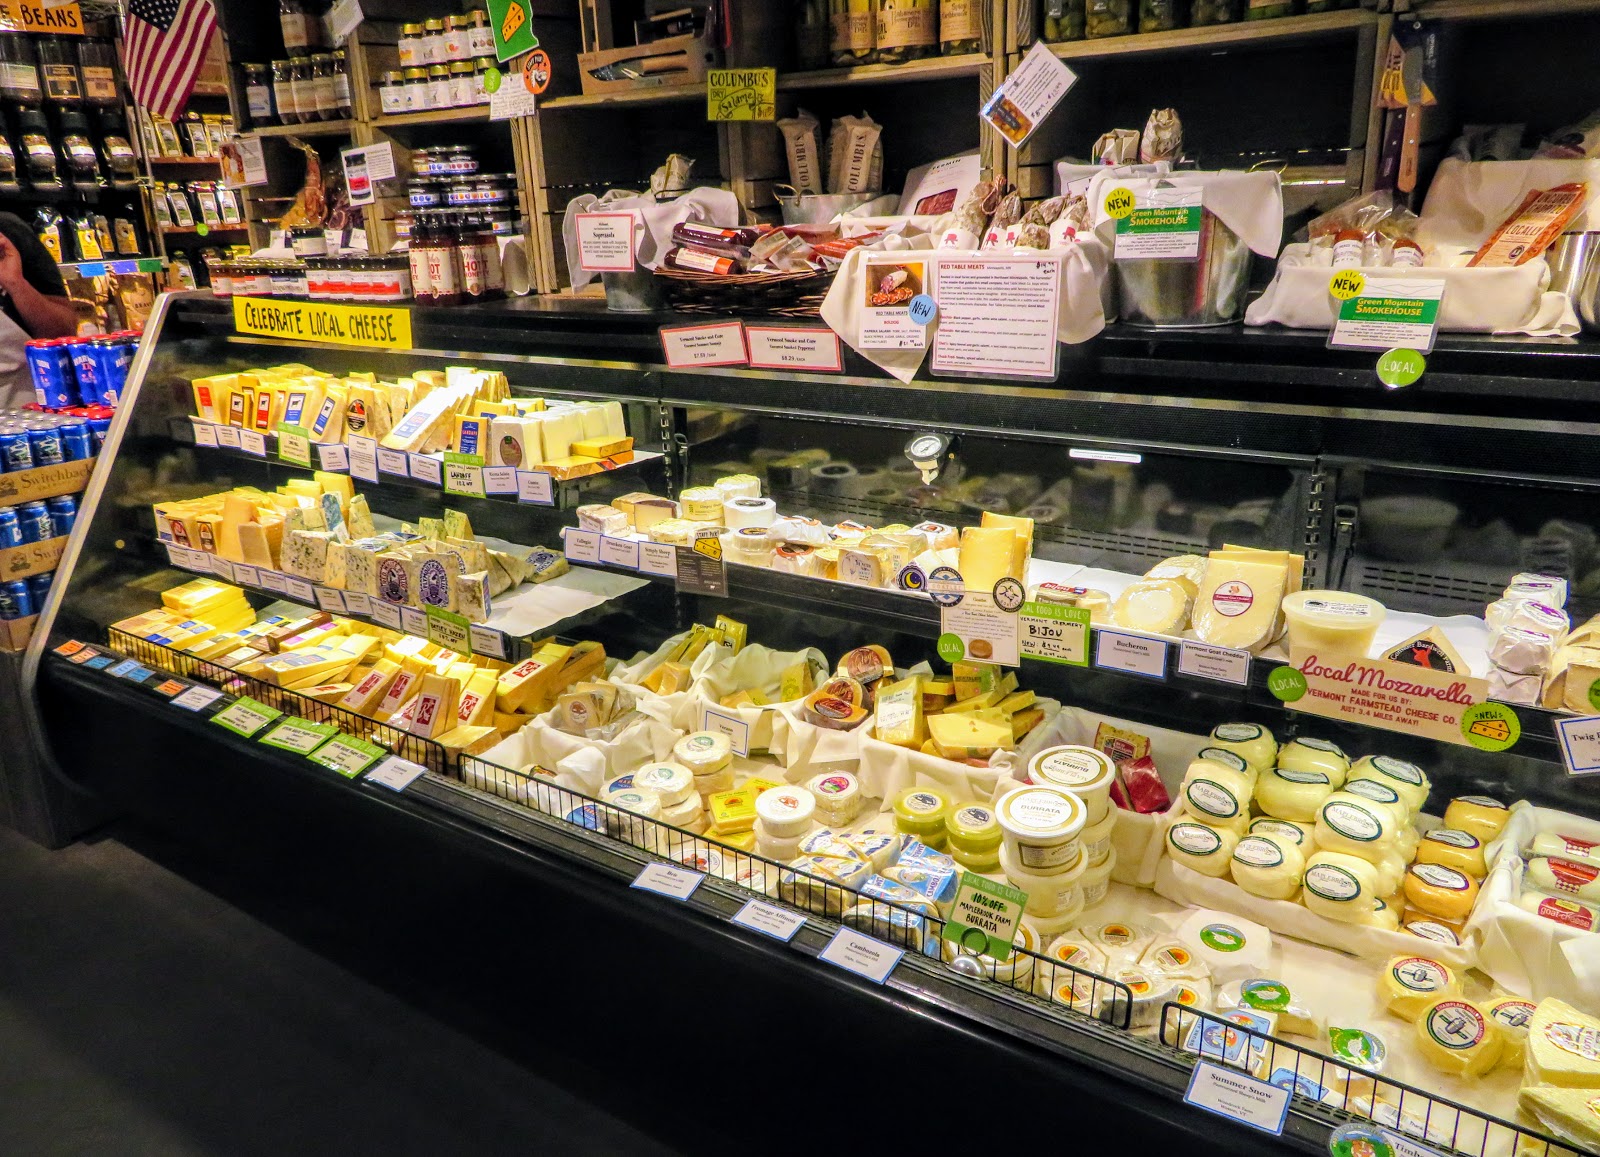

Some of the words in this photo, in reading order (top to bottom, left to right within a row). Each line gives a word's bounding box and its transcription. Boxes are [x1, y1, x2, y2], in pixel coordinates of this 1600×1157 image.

[20, 4, 78, 28] BEANS
[710, 72, 769, 88] COLUMBUS
[794, 135, 809, 188] COLUMBUS
[848, 134, 867, 192] COLUMBUS
[1107, 196, 1131, 212] NEW
[1153, 208, 1189, 216] Mountain
[1129, 216, 1188, 226] SMOKEHOUSE
[1505, 224, 1545, 236] LOCALLY
[1333, 278, 1360, 292] NEW
[911, 300, 932, 317] NEW
[1355, 304, 1423, 316] SMOKEHOUSE
[1383, 299, 1424, 307] Mountain
[244, 302, 303, 334] CELEBRATE
[308, 311, 346, 338] LOCAL
[349, 313, 397, 343] CHEESE
[1383, 360, 1416, 374] LOCAL
[1036, 605, 1053, 616] FOOD
[1064, 608, 1082, 620] LOVE
[1028, 624, 1063, 637] BIJOU
[940, 642, 961, 653] LOCAL
[1116, 640, 1148, 651] Bucheron
[1184, 643, 1208, 653] Vermont
[1222, 650, 1245, 660] Cheddar
[1272, 677, 1301, 691] LOCAL
[1299, 655, 1357, 683] Local
[1358, 666, 1475, 706] Mozzarella
[1351, 688, 1370, 697] MADE
[1373, 692, 1386, 700] FOR
[1388, 695, 1398, 703] US
[1400, 697, 1412, 705] BY:
[1307, 688, 1346, 703] VERMONT
[1349, 697, 1401, 714] FARMSTEAD
[1405, 708, 1439, 721] CHEESE
[1442, 715, 1458, 725] CO.
[1340, 705, 1356, 713] JUST
[1373, 711, 1393, 721] MILES
[1395, 716, 1419, 726] AWAY!
[1479, 711, 1498, 719] NEW
[1571, 733, 1595, 741] Twig
[1020, 804, 1061, 814] BURRATA
[972, 892, 988, 907] 10%
[989, 899, 1004, 912] OFF
[751, 903, 776, 917] Fromage
[775, 911, 797, 925] Affinois
[959, 901, 994, 920] MAPLEBROOK
[994, 914, 1011, 926] FARM
[966, 913, 997, 934] BURRATA
[849, 941, 880, 958] Cambozola
[1435, 1001, 1466, 1012] CHAMPLAIN
[1210, 1073, 1248, 1091] Summer
[1248, 1086, 1273, 1099] Snow
